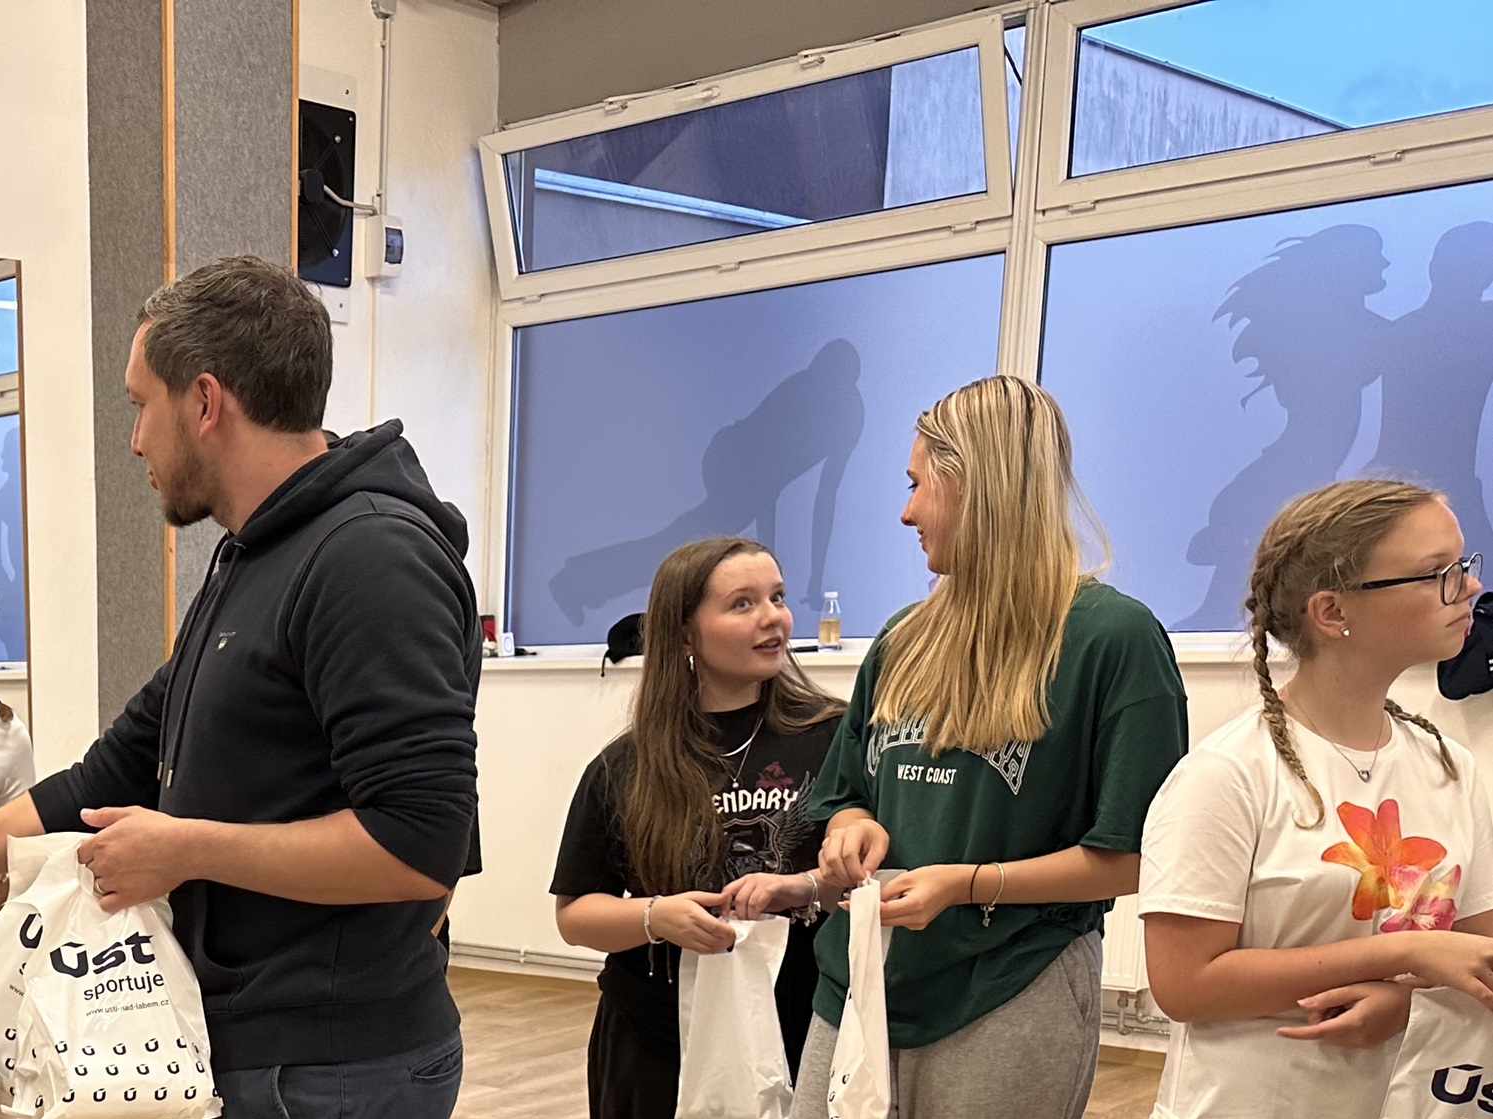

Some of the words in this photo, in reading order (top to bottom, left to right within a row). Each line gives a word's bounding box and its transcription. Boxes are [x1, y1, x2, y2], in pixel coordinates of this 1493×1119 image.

[897, 764, 924, 781] WEST
[926, 767, 957, 785] COAST
[711, 787, 799, 814] ENDARY
[83, 971, 165, 1001] sportuje
